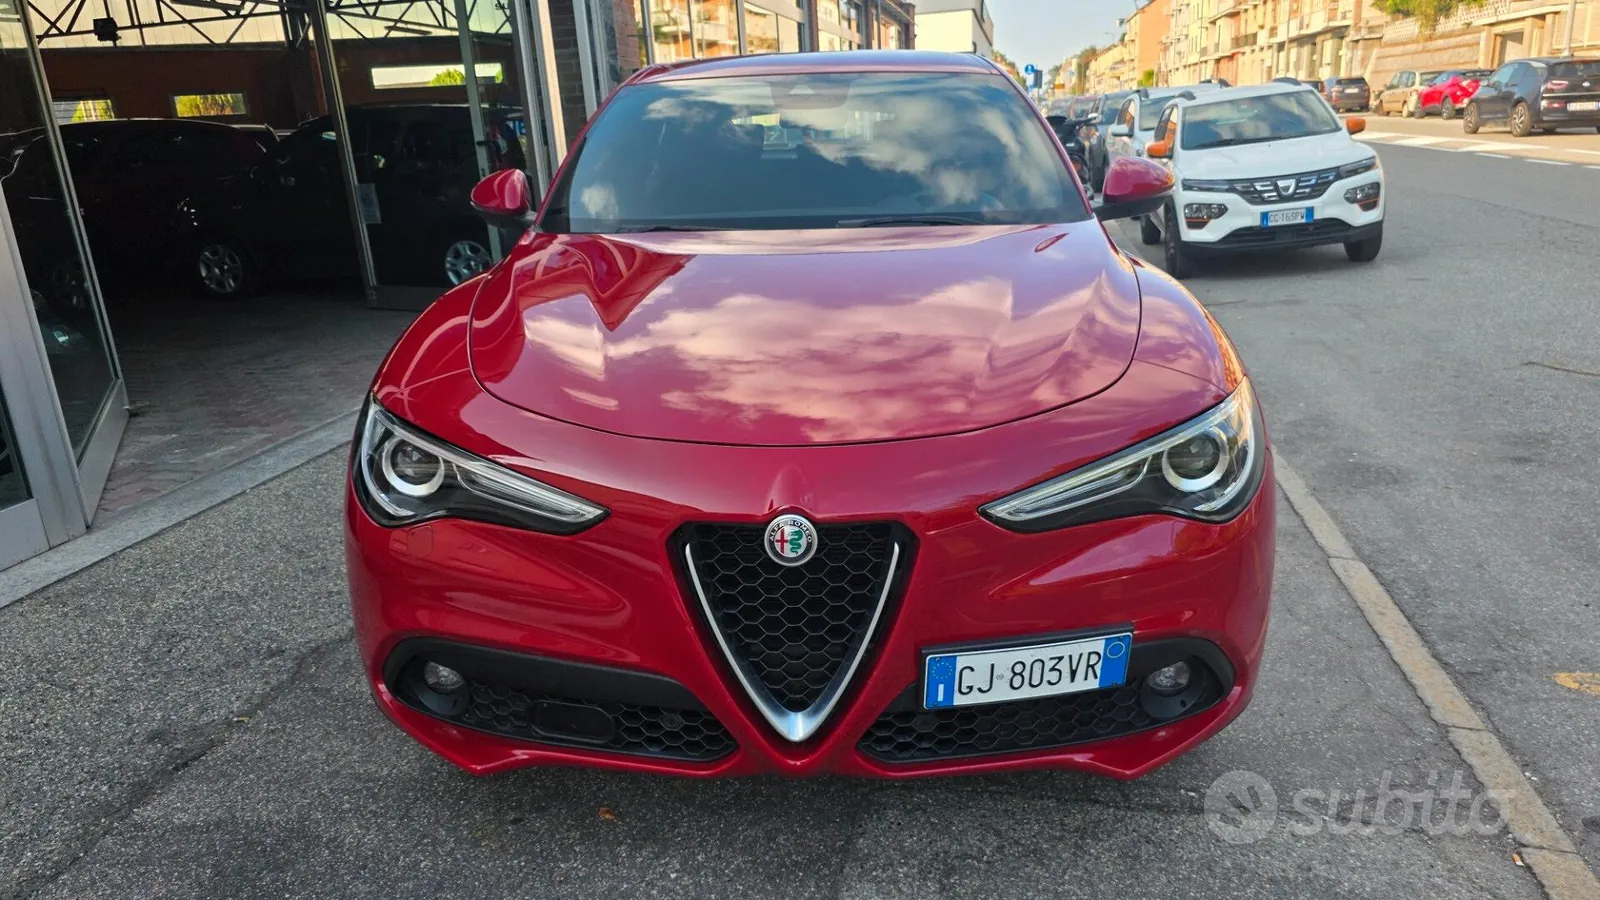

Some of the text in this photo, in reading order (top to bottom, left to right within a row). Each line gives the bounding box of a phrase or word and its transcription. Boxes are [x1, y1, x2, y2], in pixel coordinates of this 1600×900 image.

[770, 520, 812, 542] ALFA ROMEO
[957, 651, 1102, 695] GJ 803VR
